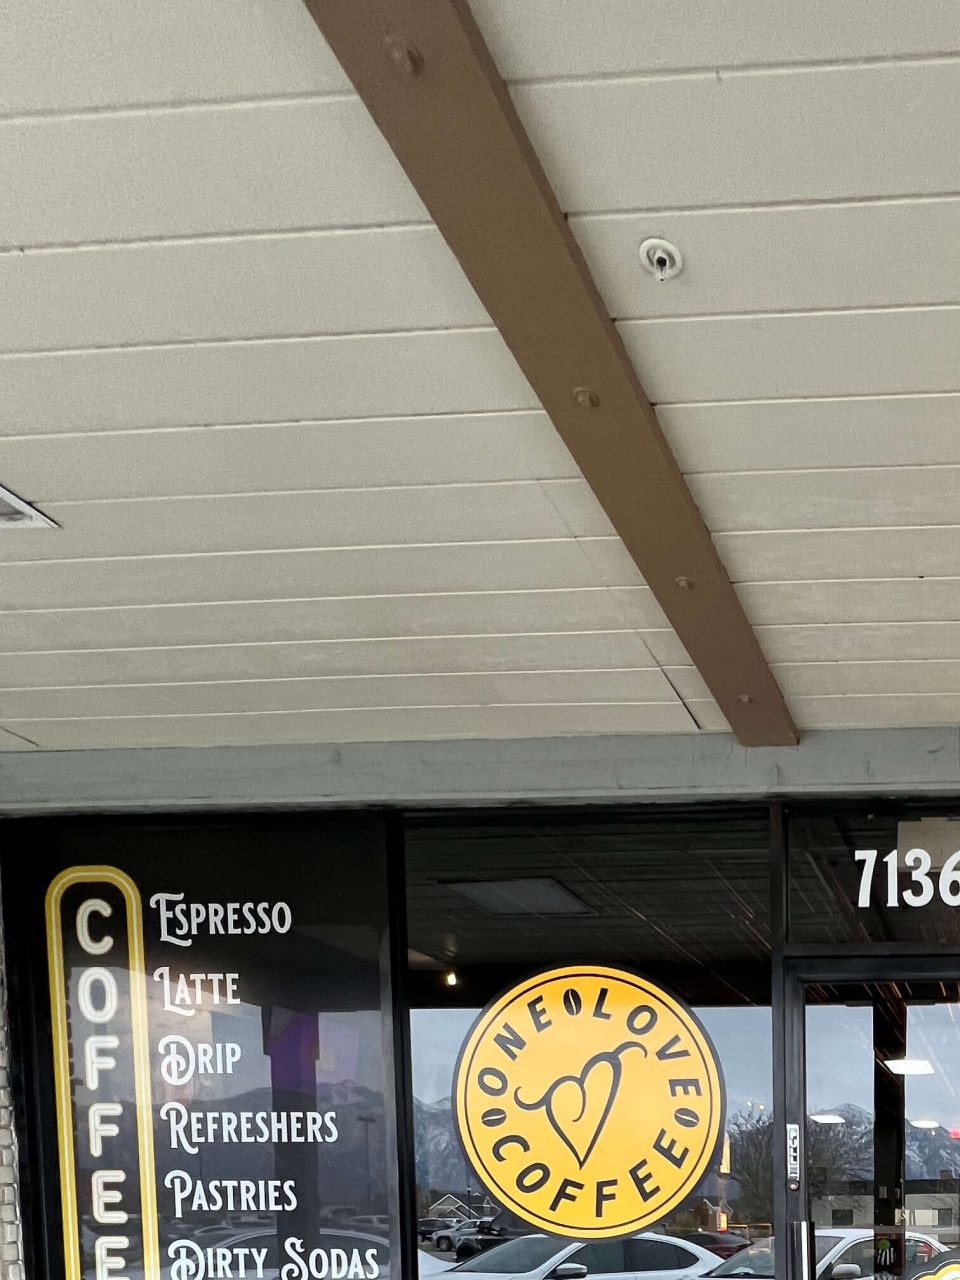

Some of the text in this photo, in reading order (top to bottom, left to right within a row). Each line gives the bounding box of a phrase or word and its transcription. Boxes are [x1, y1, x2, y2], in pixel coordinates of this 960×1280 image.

[149, 892, 292, 947] ESPRESSO
[153, 966, 241, 1017] LATTE
[157, 1034, 242, 1085] DRIP
[477, 987, 702, 1097] ONE LOVE
[160, 1101, 339, 1155] REFRESHERS
[789, 1130, 798, 1164] PULL
[164, 1169, 298, 1218] PASTRIES
[491, 1128, 690, 1218] COFFEE
